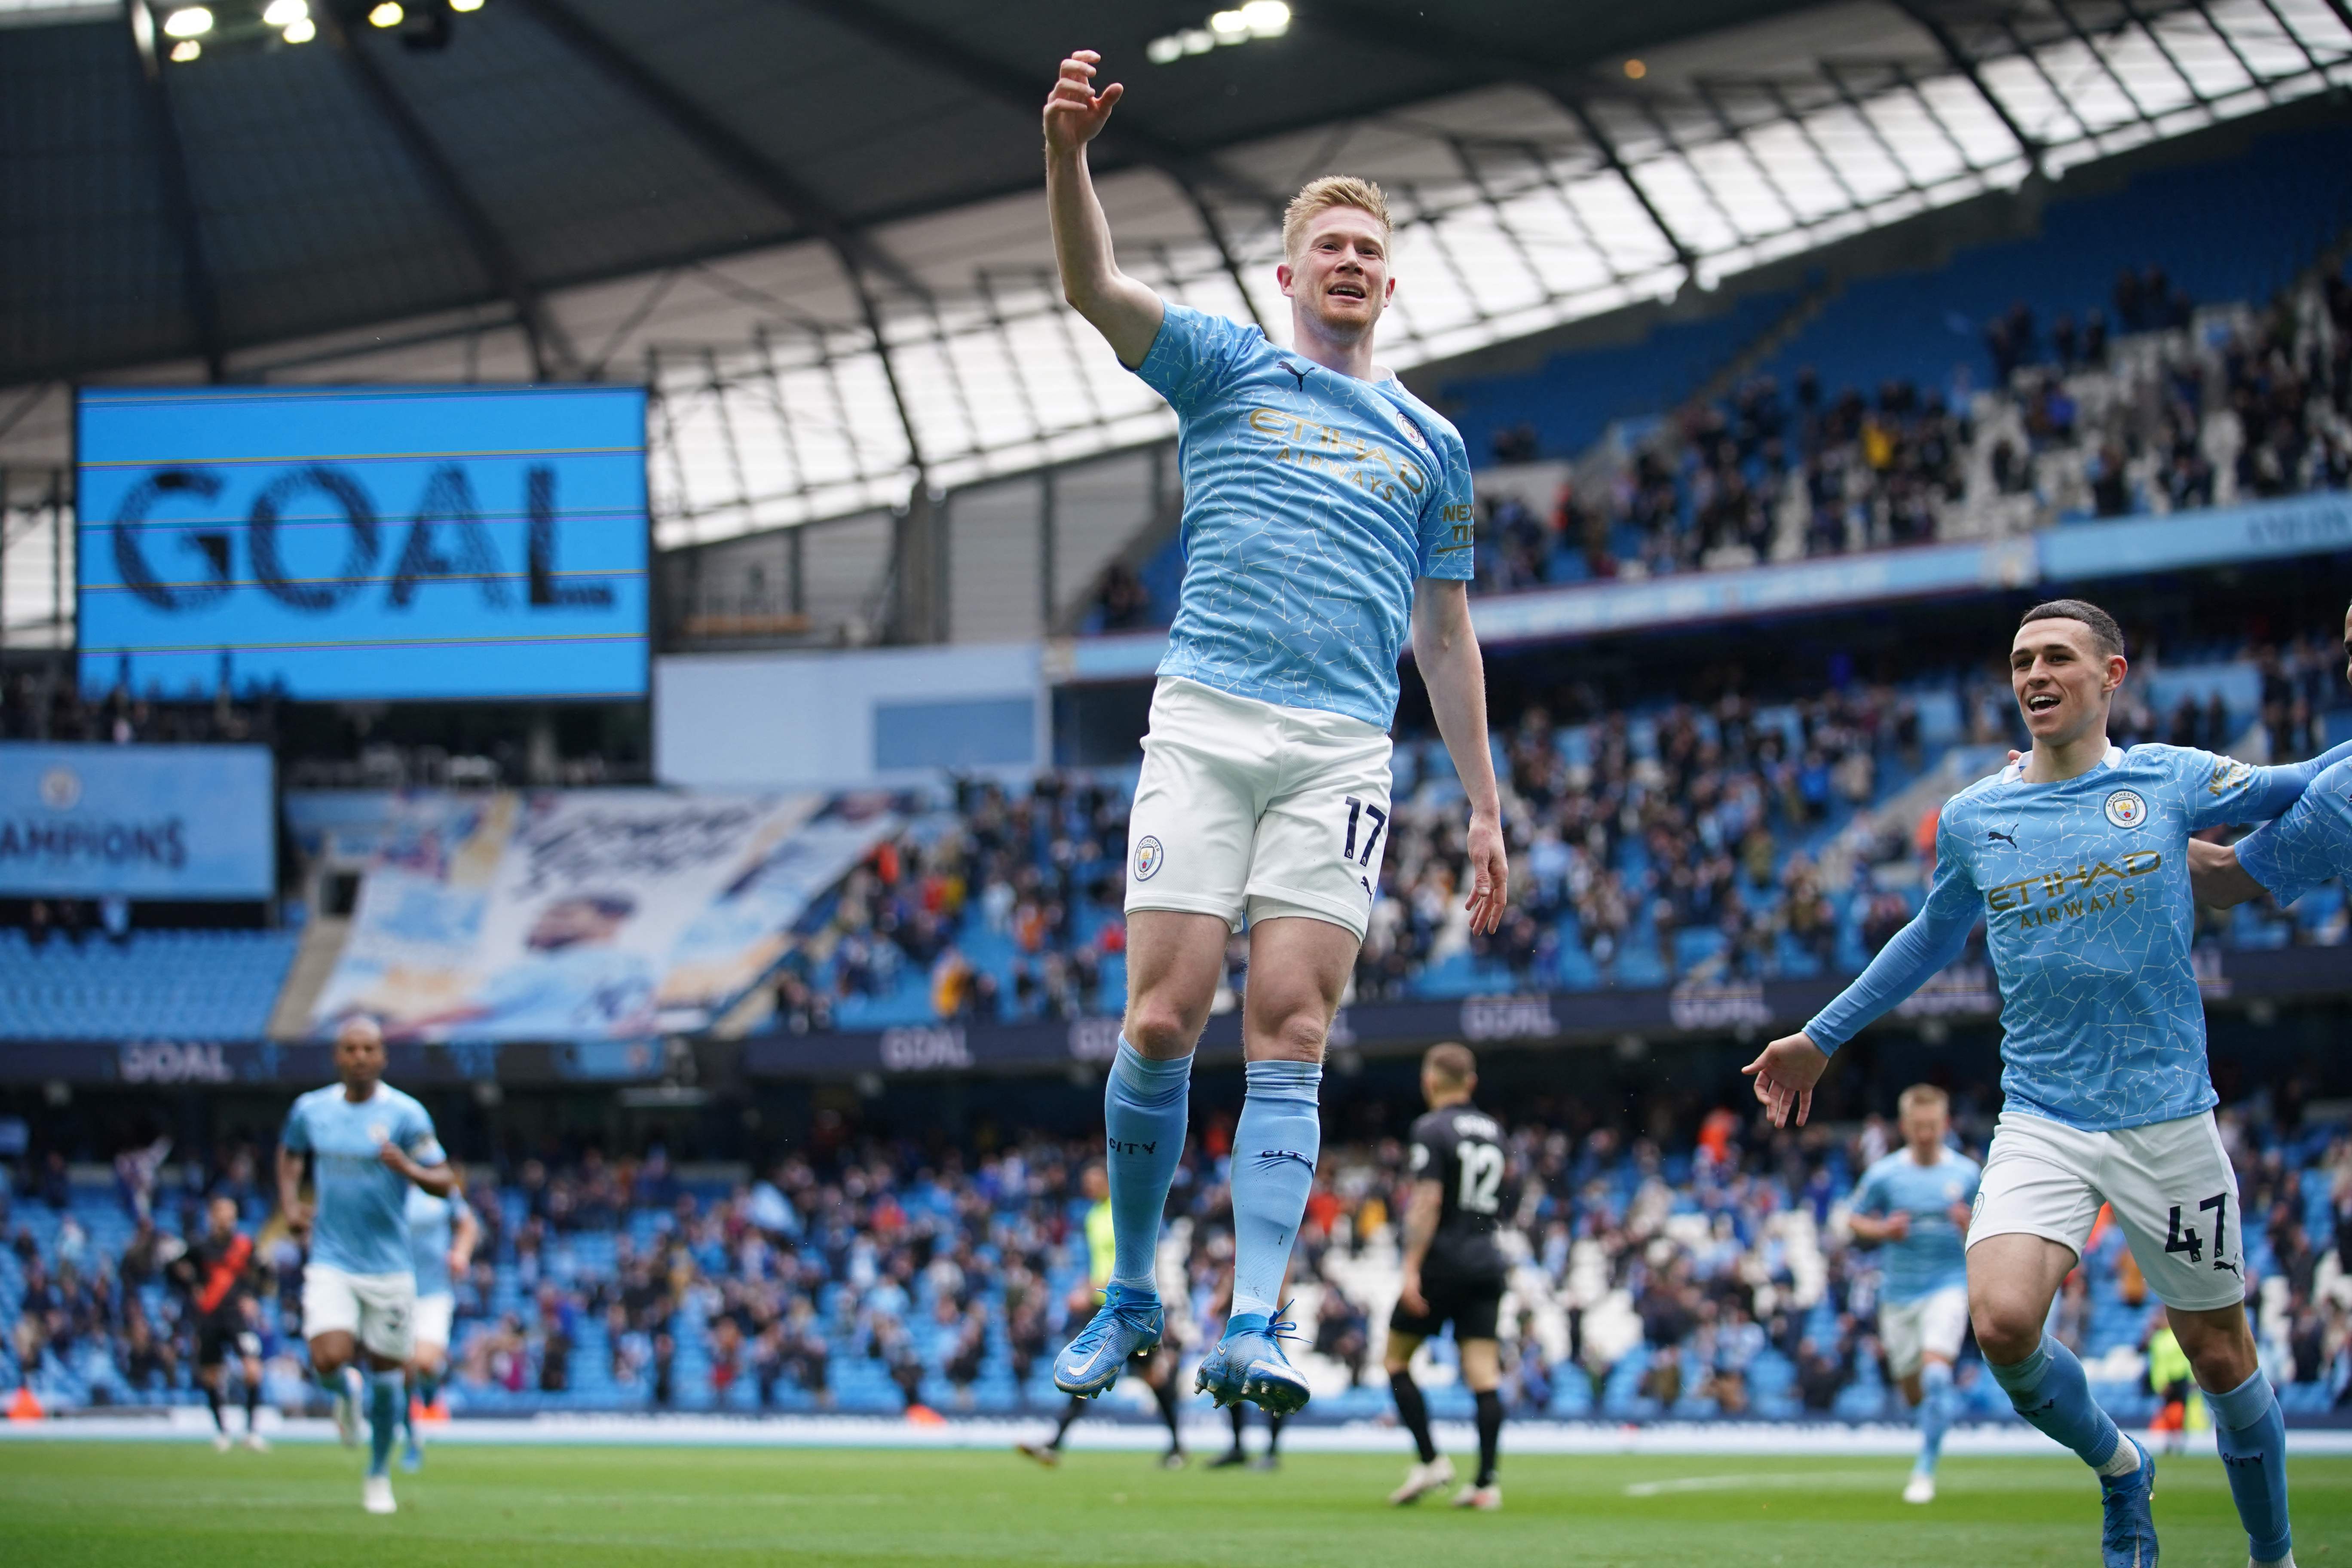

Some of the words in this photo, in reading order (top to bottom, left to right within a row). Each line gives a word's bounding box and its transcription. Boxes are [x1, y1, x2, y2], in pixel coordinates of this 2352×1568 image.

[1250, 407, 1424, 494] ETIHAD
[1276, 445, 1395, 502] AIRWAYS
[113, 464, 613, 613] GOAL
[2107, 792, 2141, 807] MANCHESTER
[1137, 839, 1160, 854] MANCHESTER
[1344, 796, 1387, 867] 17
[1988, 850, 2161, 911] ETIHAD
[2021, 888, 2135, 930] AIRWAYS
[1109, 1137, 1157, 1155] CITY
[1456, 1140, 1505, 1215] 12
[2165, 1192, 2226, 1263] 47
[2223, 1452, 2263, 1467] CITY
